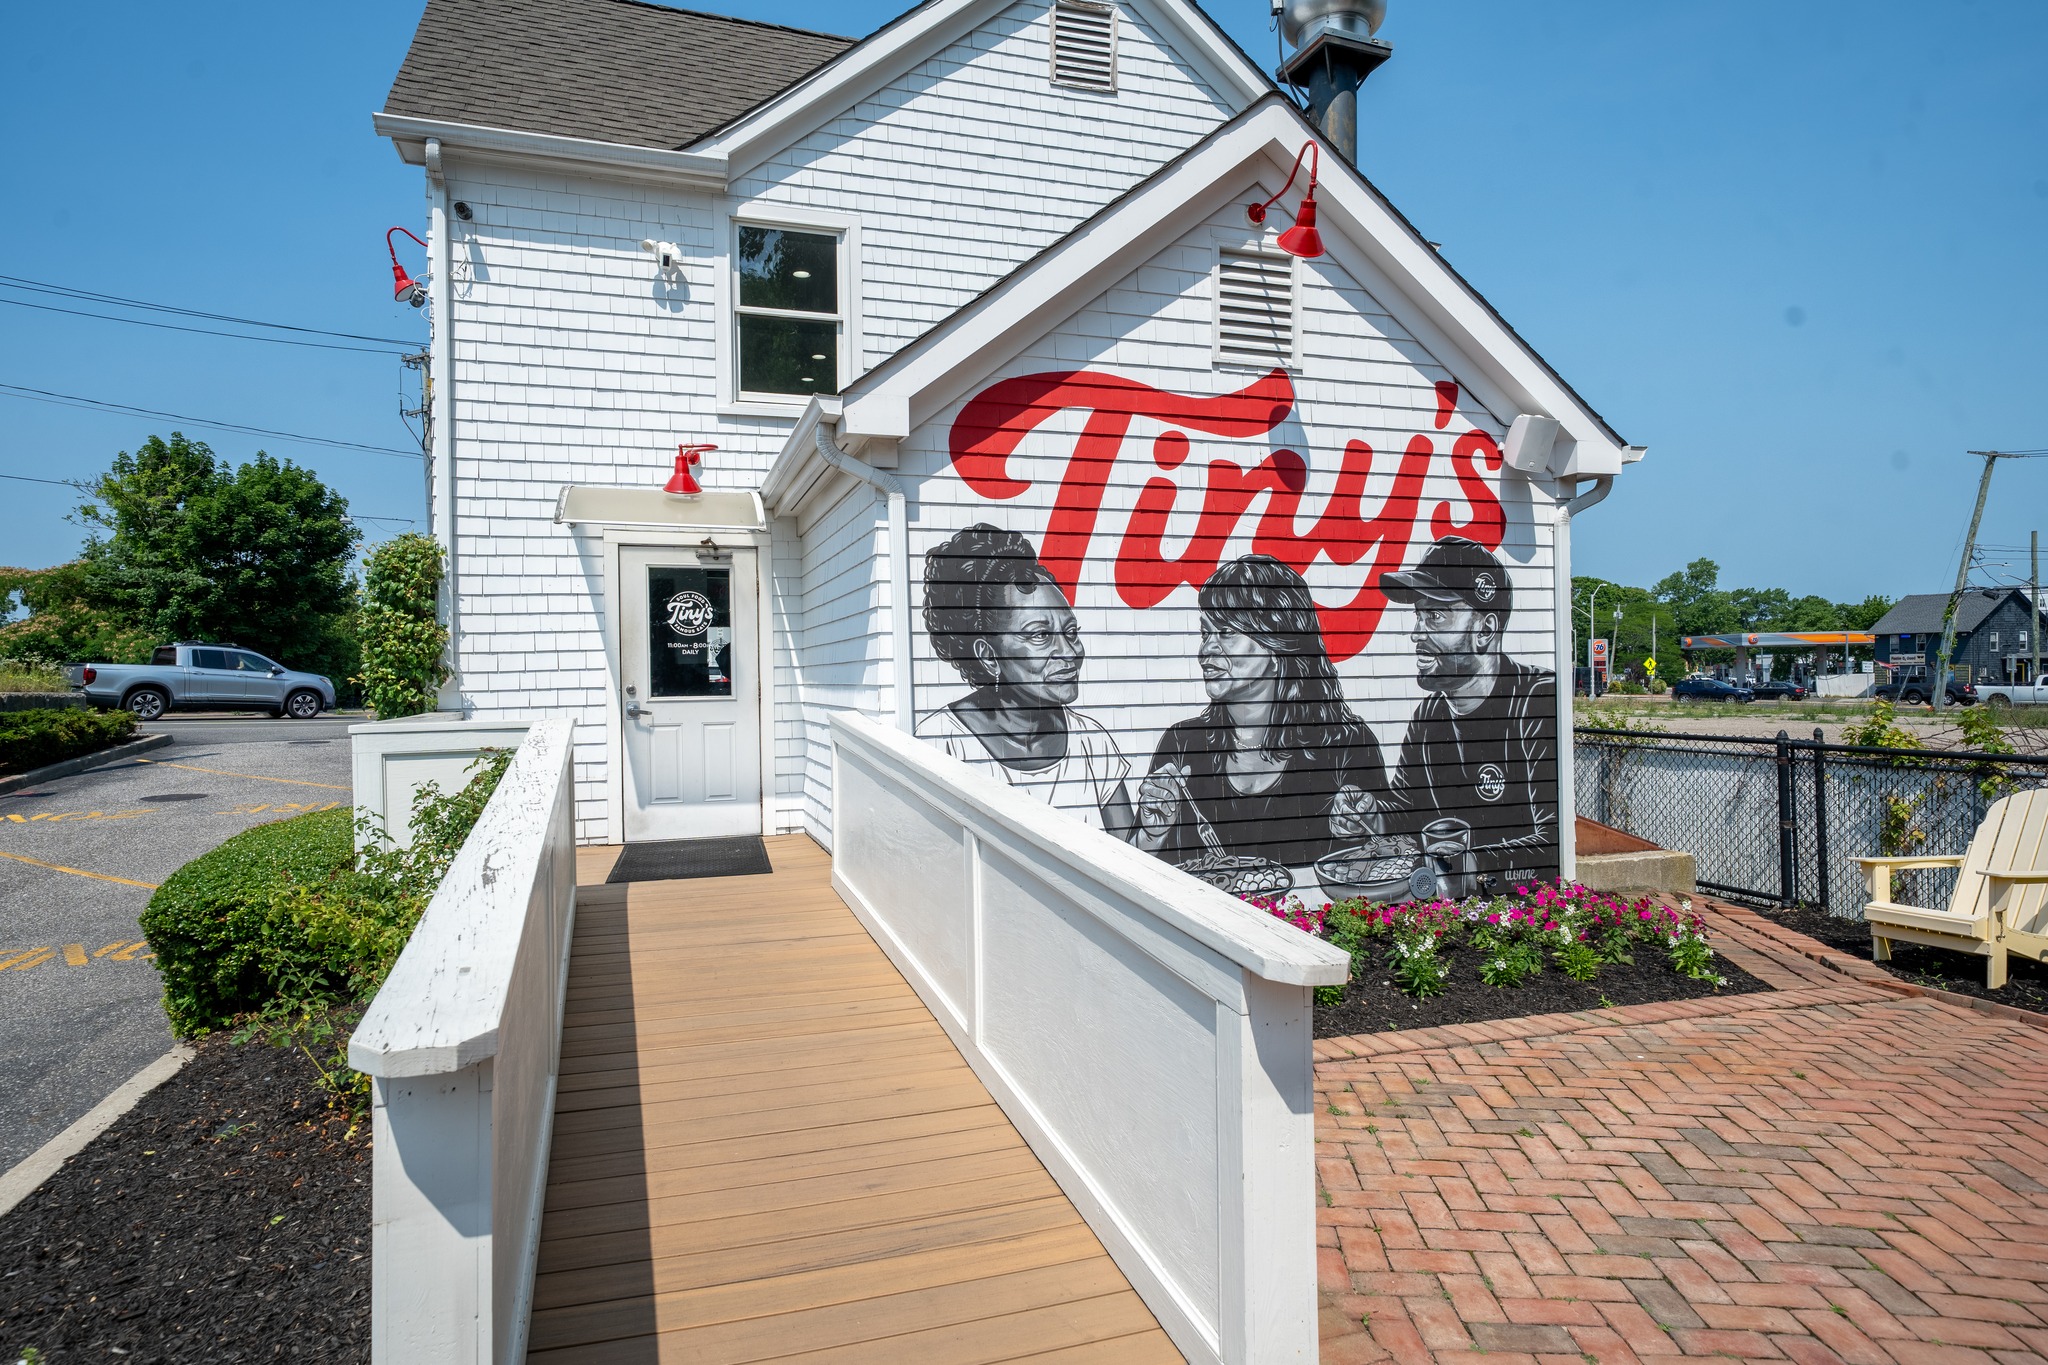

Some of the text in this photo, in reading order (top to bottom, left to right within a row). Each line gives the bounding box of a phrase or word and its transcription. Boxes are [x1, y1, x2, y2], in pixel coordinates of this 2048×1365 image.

[949, 368, 1507, 663] Tiny's
[676, 594, 706, 604] SOUL FOOD
[667, 601, 713, 626] Tiny's
[674, 621, 708, 633] FAMOUS EATS
